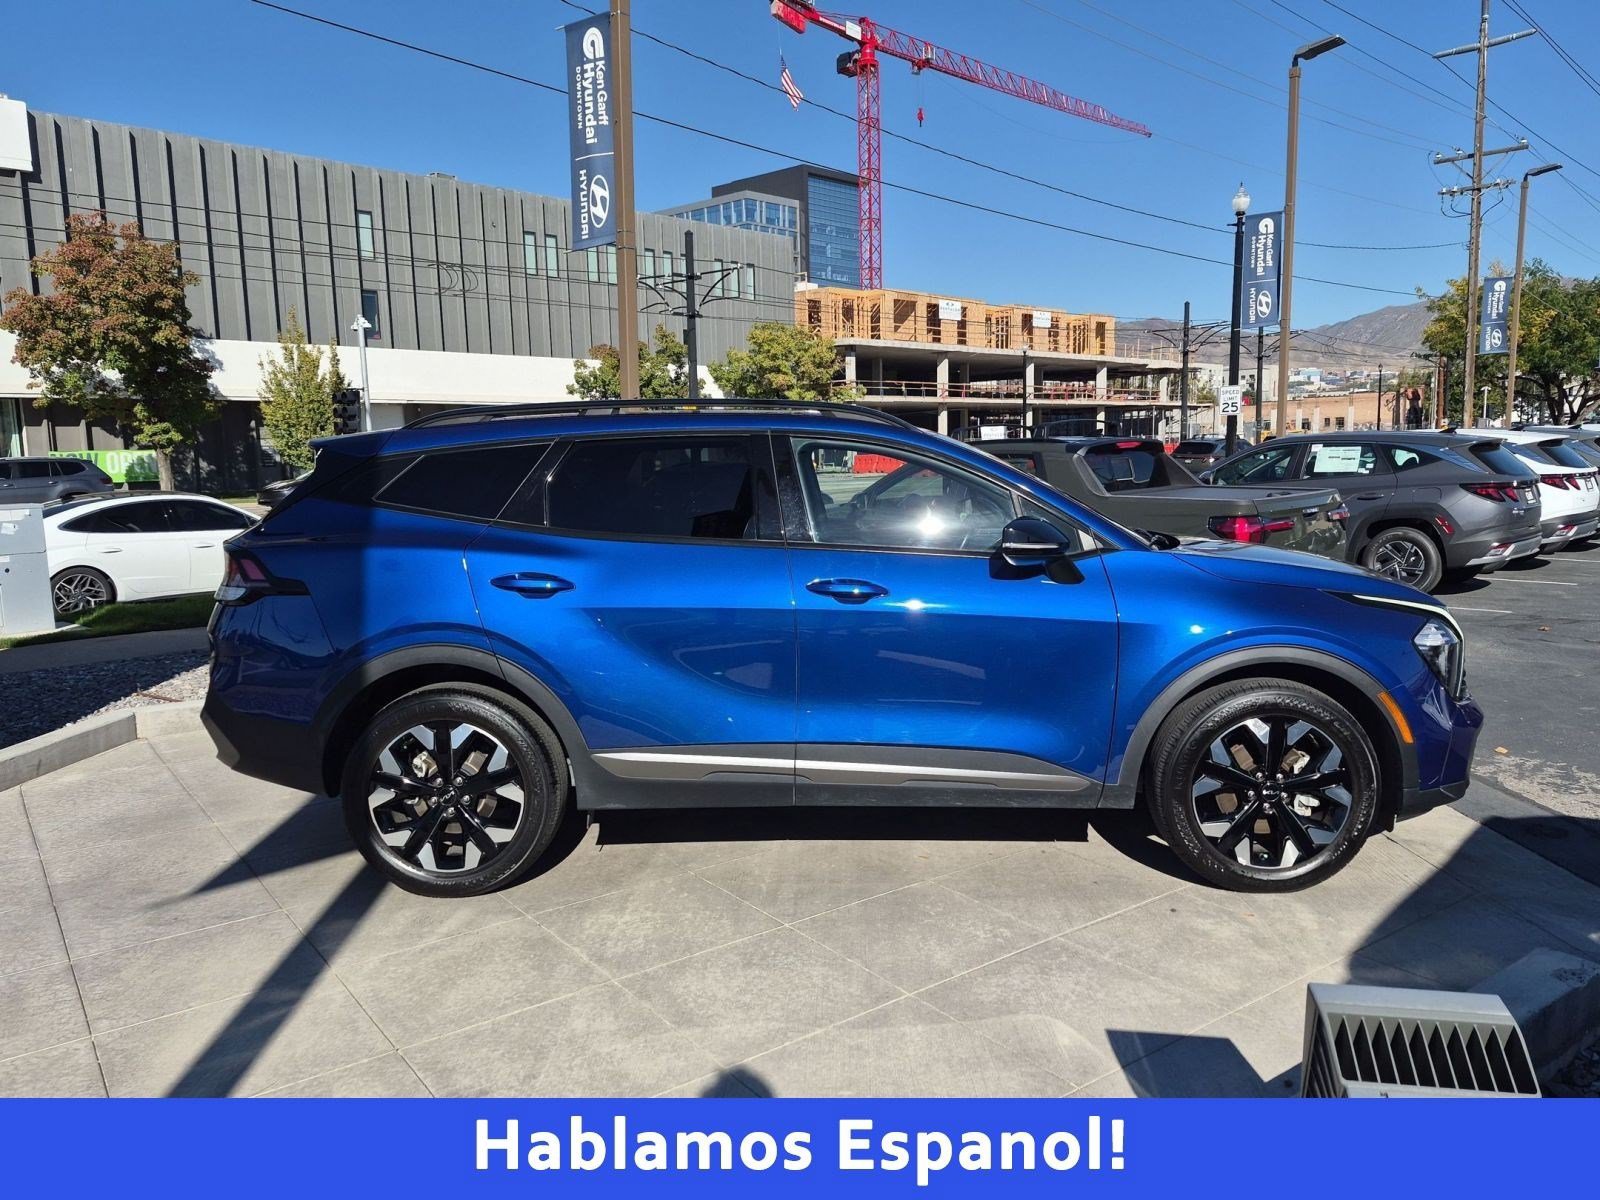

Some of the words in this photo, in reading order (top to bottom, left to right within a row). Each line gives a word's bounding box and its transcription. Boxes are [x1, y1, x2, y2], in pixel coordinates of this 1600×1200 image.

[595, 60, 605, 89] Ken
[575, 66, 583, 129] DOWNTOWN
[582, 62, 597, 144] Hyundai
[597, 90, 609, 125] Garff
[579, 169, 589, 240] HYUNDAI
[1256, 235, 1266, 275] Hyundai
[1222, 402, 1239, 412] 25
